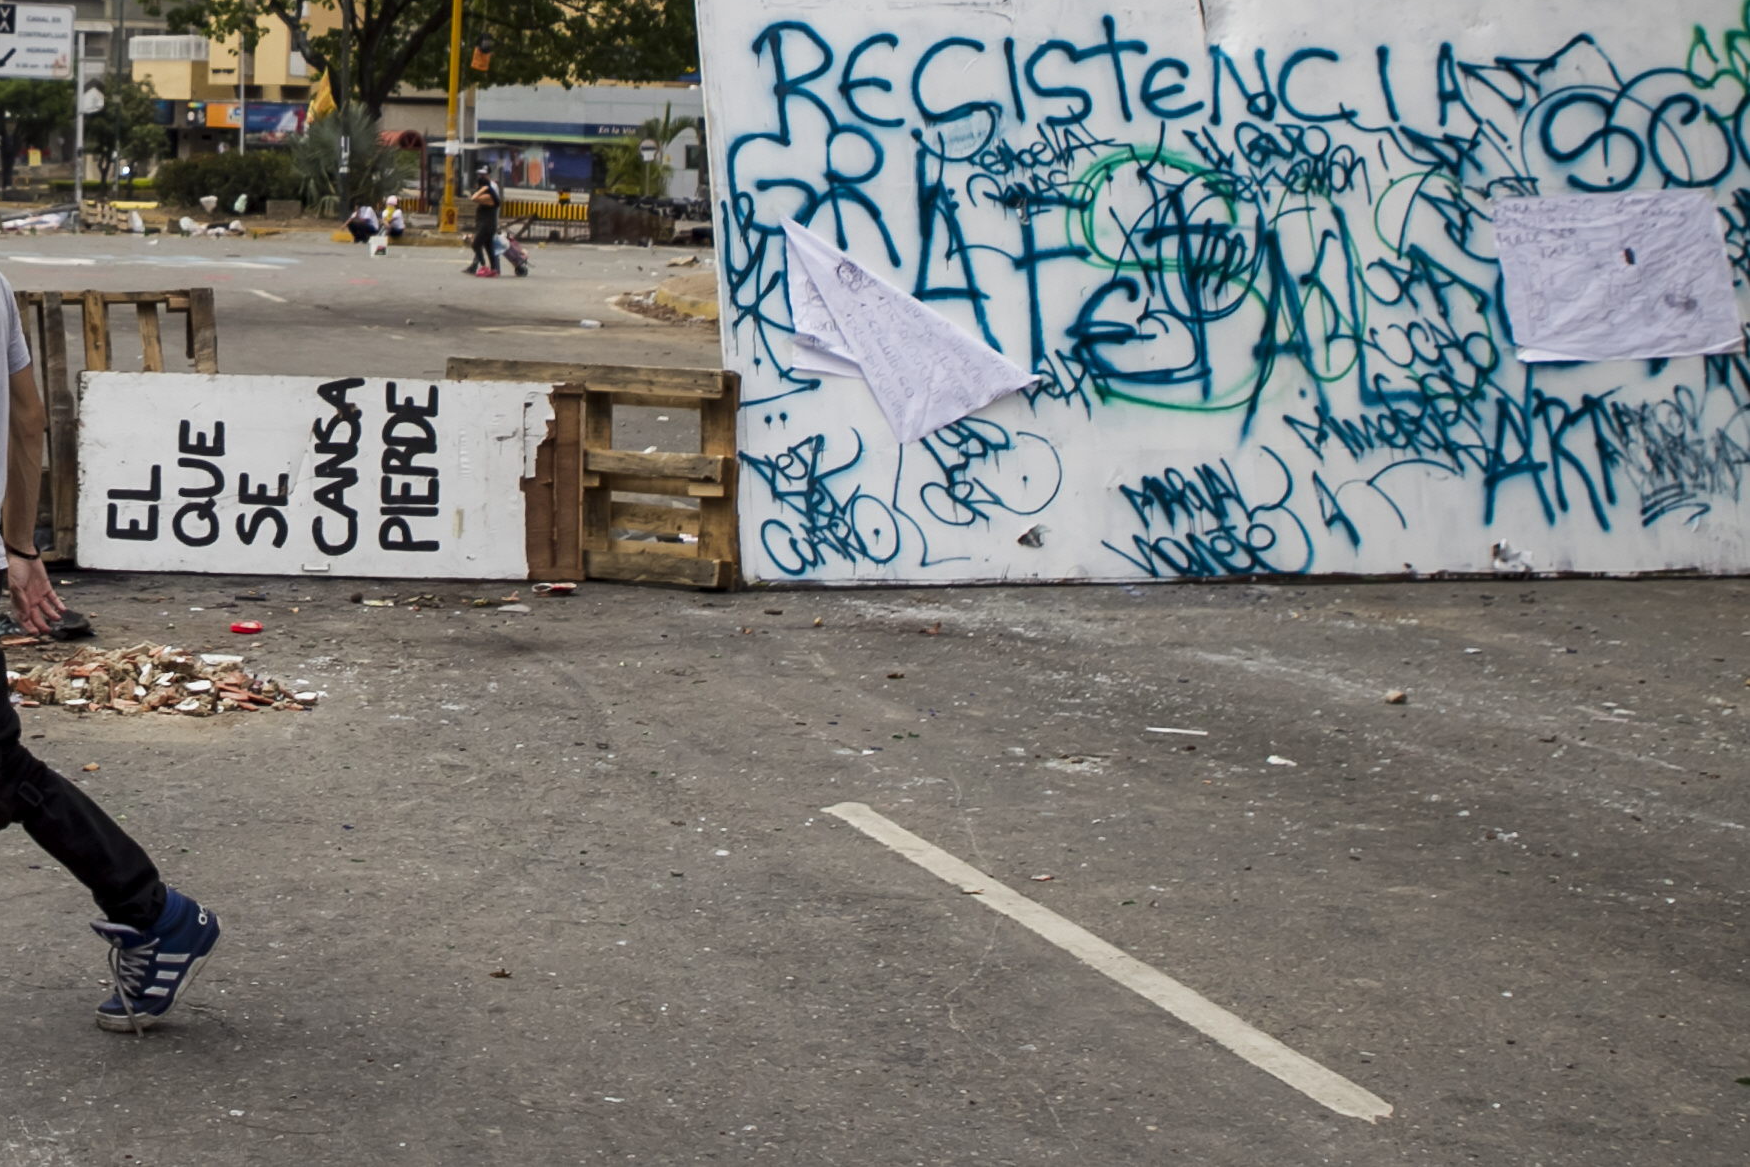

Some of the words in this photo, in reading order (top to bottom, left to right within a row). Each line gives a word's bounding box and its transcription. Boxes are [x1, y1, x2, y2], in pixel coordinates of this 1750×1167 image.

[106, 464, 162, 542] EL
[172, 419, 225, 547] QUE
[235, 471, 289, 549] SE
[311, 377, 366, 556] CANSA
[378, 380, 440, 552] PIERDE
